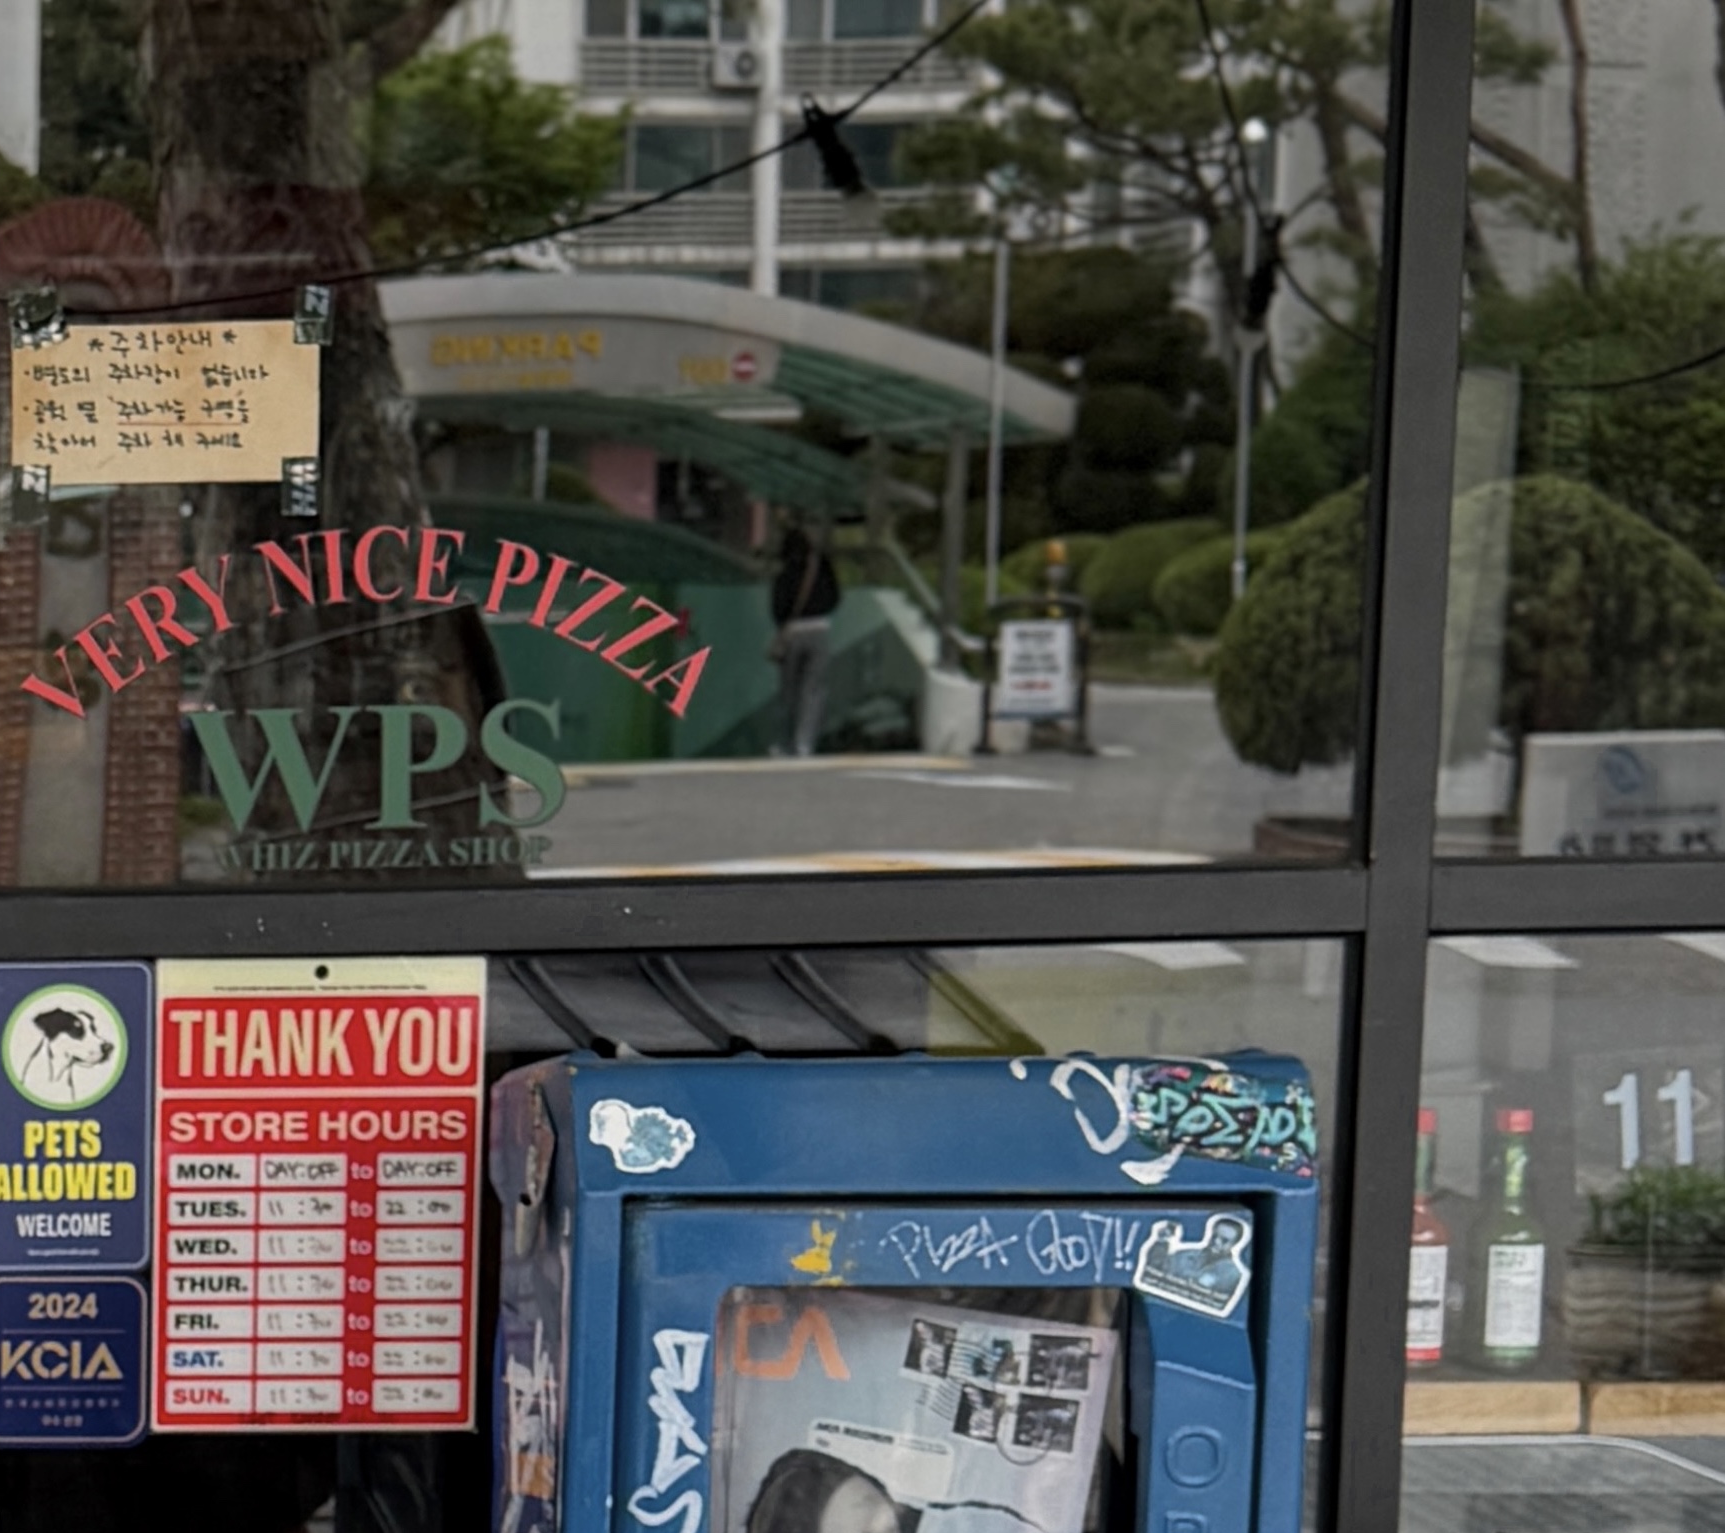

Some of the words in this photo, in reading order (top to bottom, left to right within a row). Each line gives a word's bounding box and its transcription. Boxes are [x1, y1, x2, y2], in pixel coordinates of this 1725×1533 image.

[202, 364, 269, 388] 없습니다
[21, 556, 237, 721] VERY
[255, 525, 466, 617] NICE
[483, 538, 712, 719] PIZZA
[189, 698, 567, 833] WPS
[214, 842, 319, 871] WHIZ
[328, 839, 441, 869] PIZZA
[449, 836, 552, 867] SHOP
[169, 1008, 355, 1078] THANK
[364, 1007, 474, 1077] YOU
[169, 1111, 309, 1143] STORE
[318, 1110, 468, 1142] HOURS
[1603, 1068, 1694, 1170] 11
[23, 1119, 102, 1159] PETS
[176, 1163, 241, 1180] MON.
[350, 1162, 375, 1180] to
[175, 1201, 247, 1218] TUES.
[349, 1201, 373, 1218] to
[16, 1212, 112, 1238] WELCOME
[175, 1238, 238, 1255] WED.
[349, 1238, 372, 1255] to
[175, 1276, 248, 1293] THUR.
[348, 1276, 371, 1293] to
[27, 1292, 99, 1319] 2024
[174, 1314, 219, 1330] FRI.
[348, 1314, 370, 1330] to
[0, 1340, 124, 1380] KCIA
[172, 1351, 224, 1368] SAT.
[347, 1351, 370, 1367] to
[172, 1388, 230, 1405] SUN.
[346, 1388, 369, 1405] to
